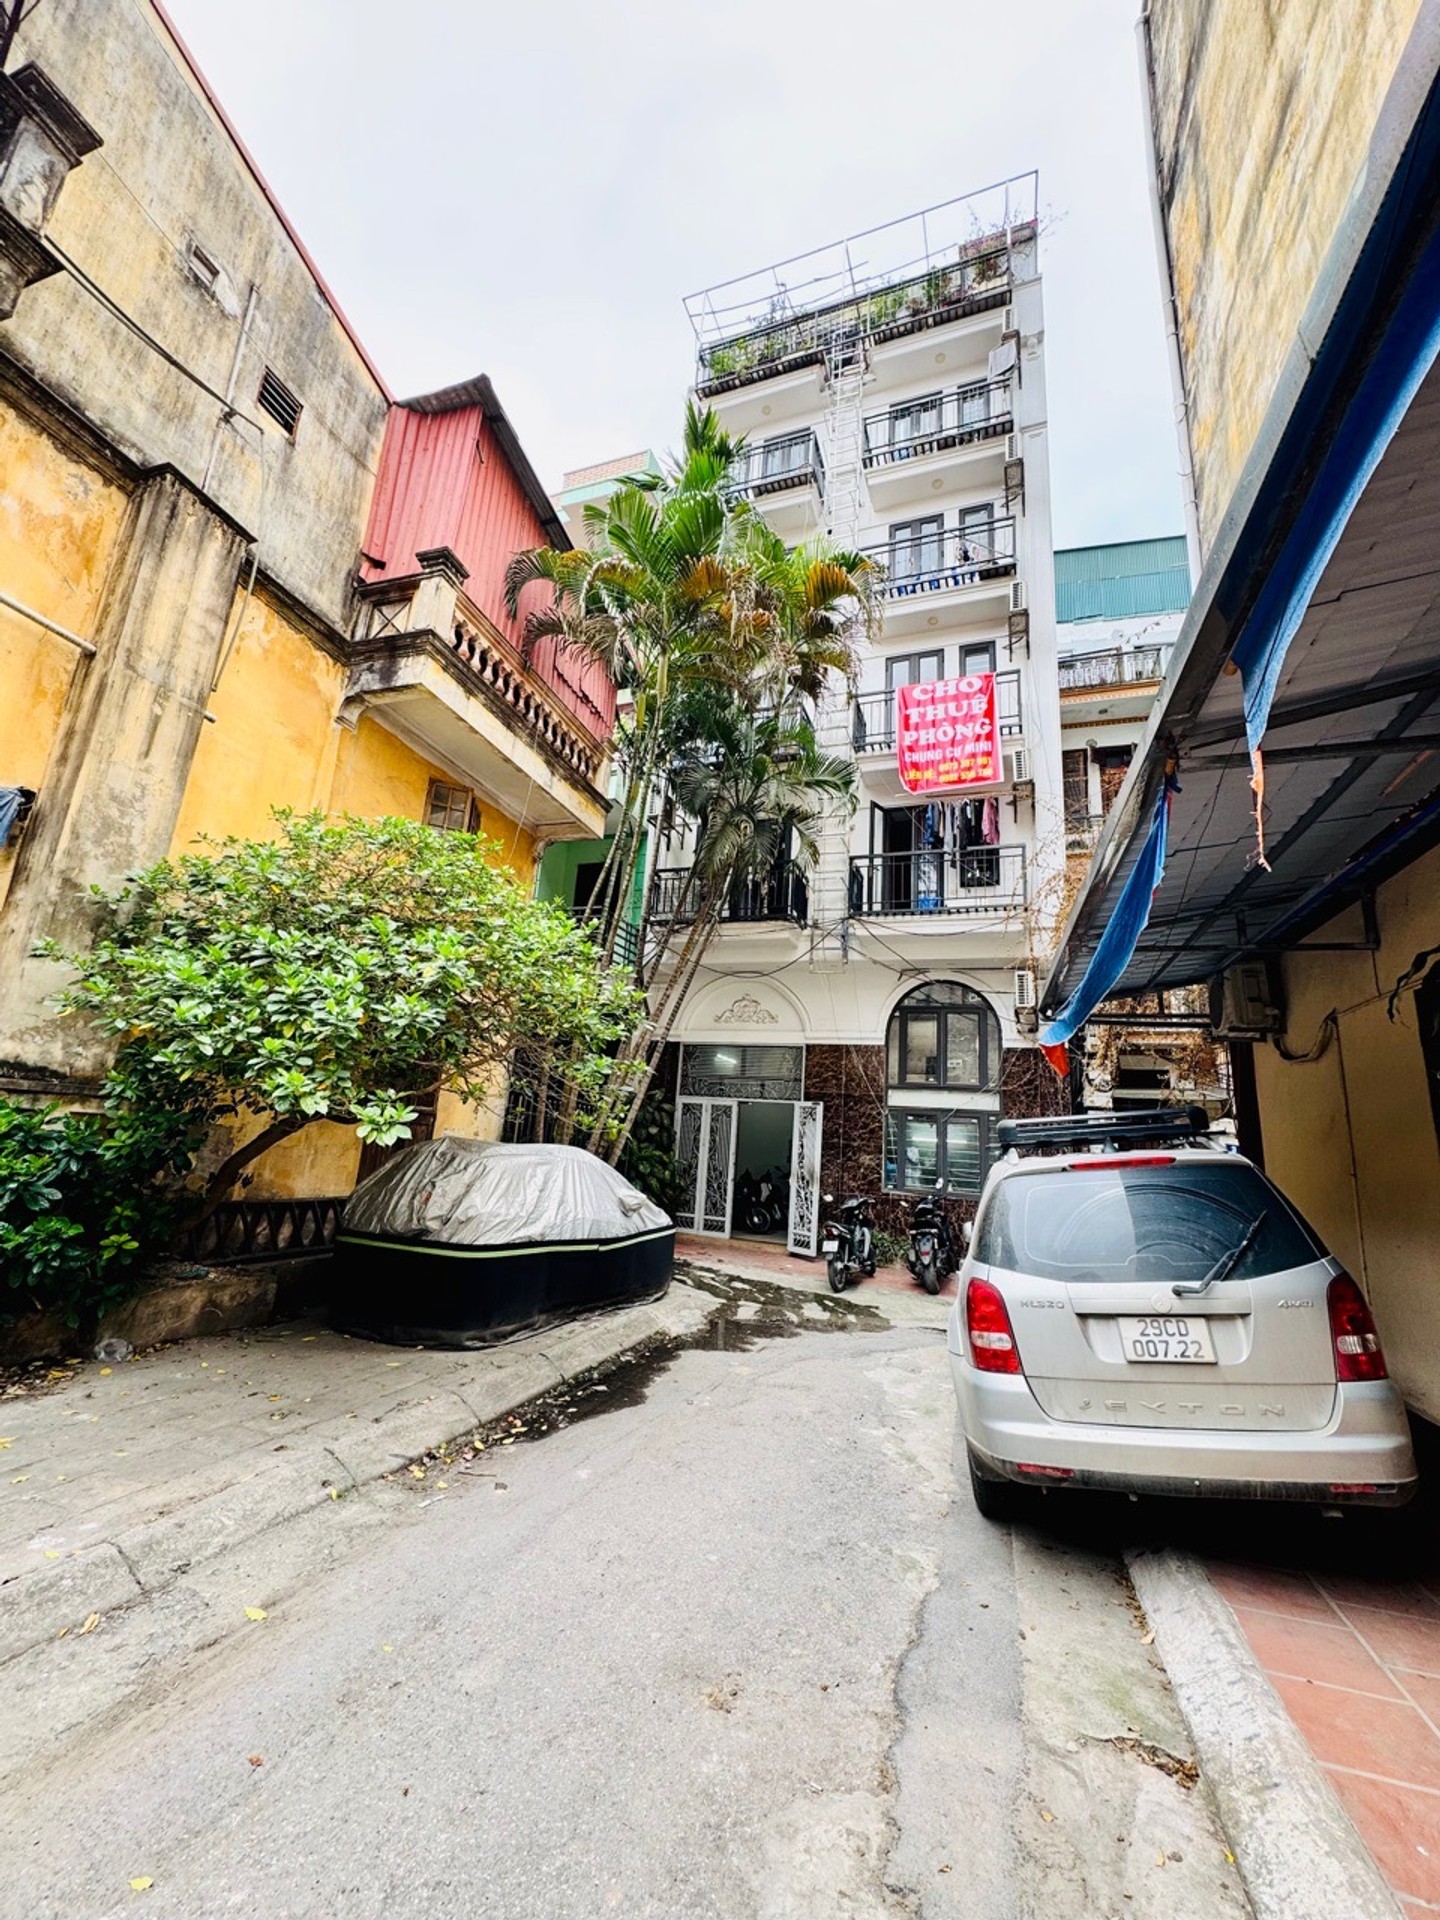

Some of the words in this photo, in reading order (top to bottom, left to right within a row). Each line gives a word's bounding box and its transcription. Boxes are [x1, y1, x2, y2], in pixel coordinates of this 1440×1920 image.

[912, 677, 982, 699] CHO
[905, 694, 988, 723] THUÊ
[903, 718, 992, 746] PHÒNG
[904, 749, 943, 762] CHUNG
[964, 741, 992, 754] MINI
[1137, 1319, 1189, 1337] 29CD
[1132, 1339, 1205, 1359] 007.22
